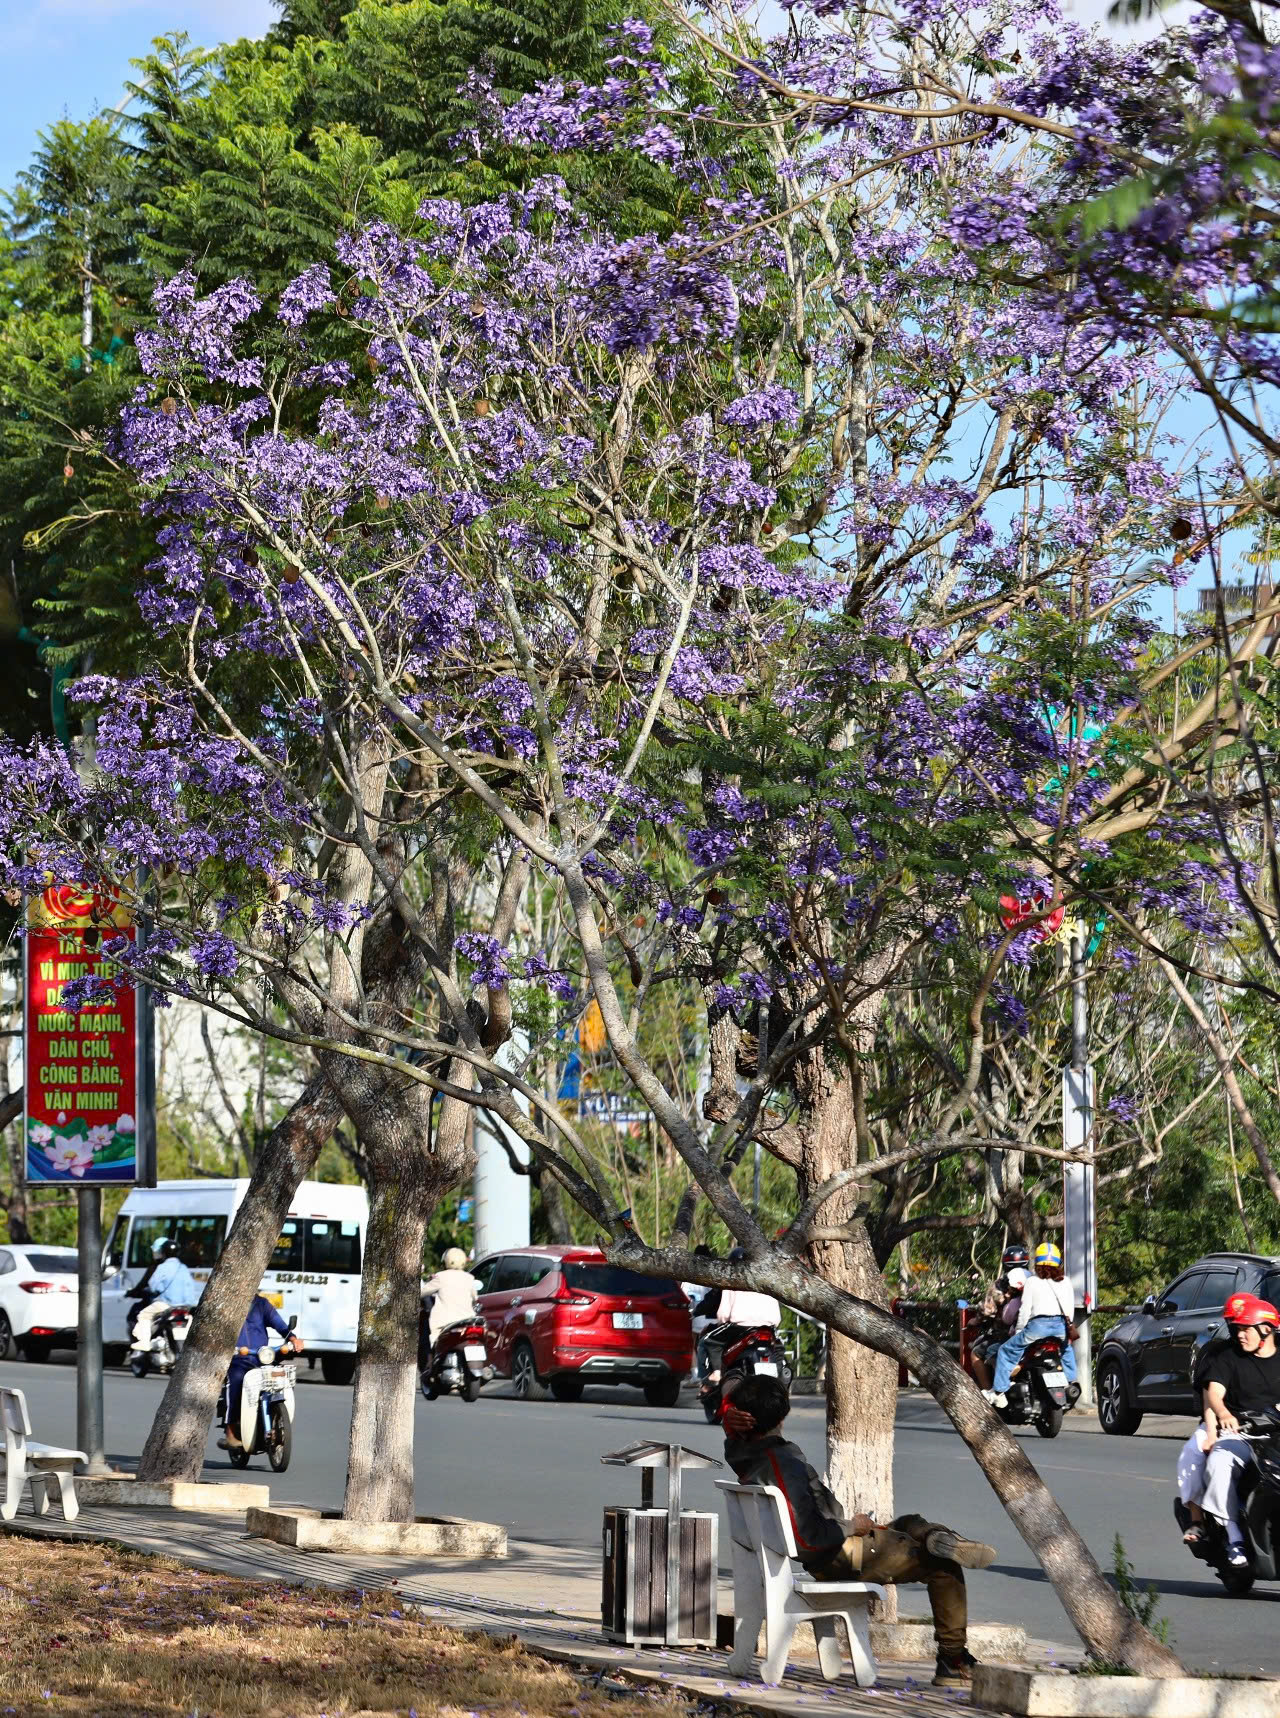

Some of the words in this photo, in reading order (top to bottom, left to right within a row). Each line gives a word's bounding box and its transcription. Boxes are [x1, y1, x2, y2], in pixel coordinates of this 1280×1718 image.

[40, 958, 54, 980] VÌ
[38, 1010, 75, 1032] NƯỚC
[80, 1014, 125, 1036] MẠNH,
[49, 1037, 78, 1058] DÂN
[81, 1034, 114, 1059] CHỦ,
[40, 1062, 77, 1084] CÔNG
[81, 1059, 123, 1085] BẰNG,
[44, 1089, 72, 1110] VĂN
[76, 1092, 118, 1110] MINH!
